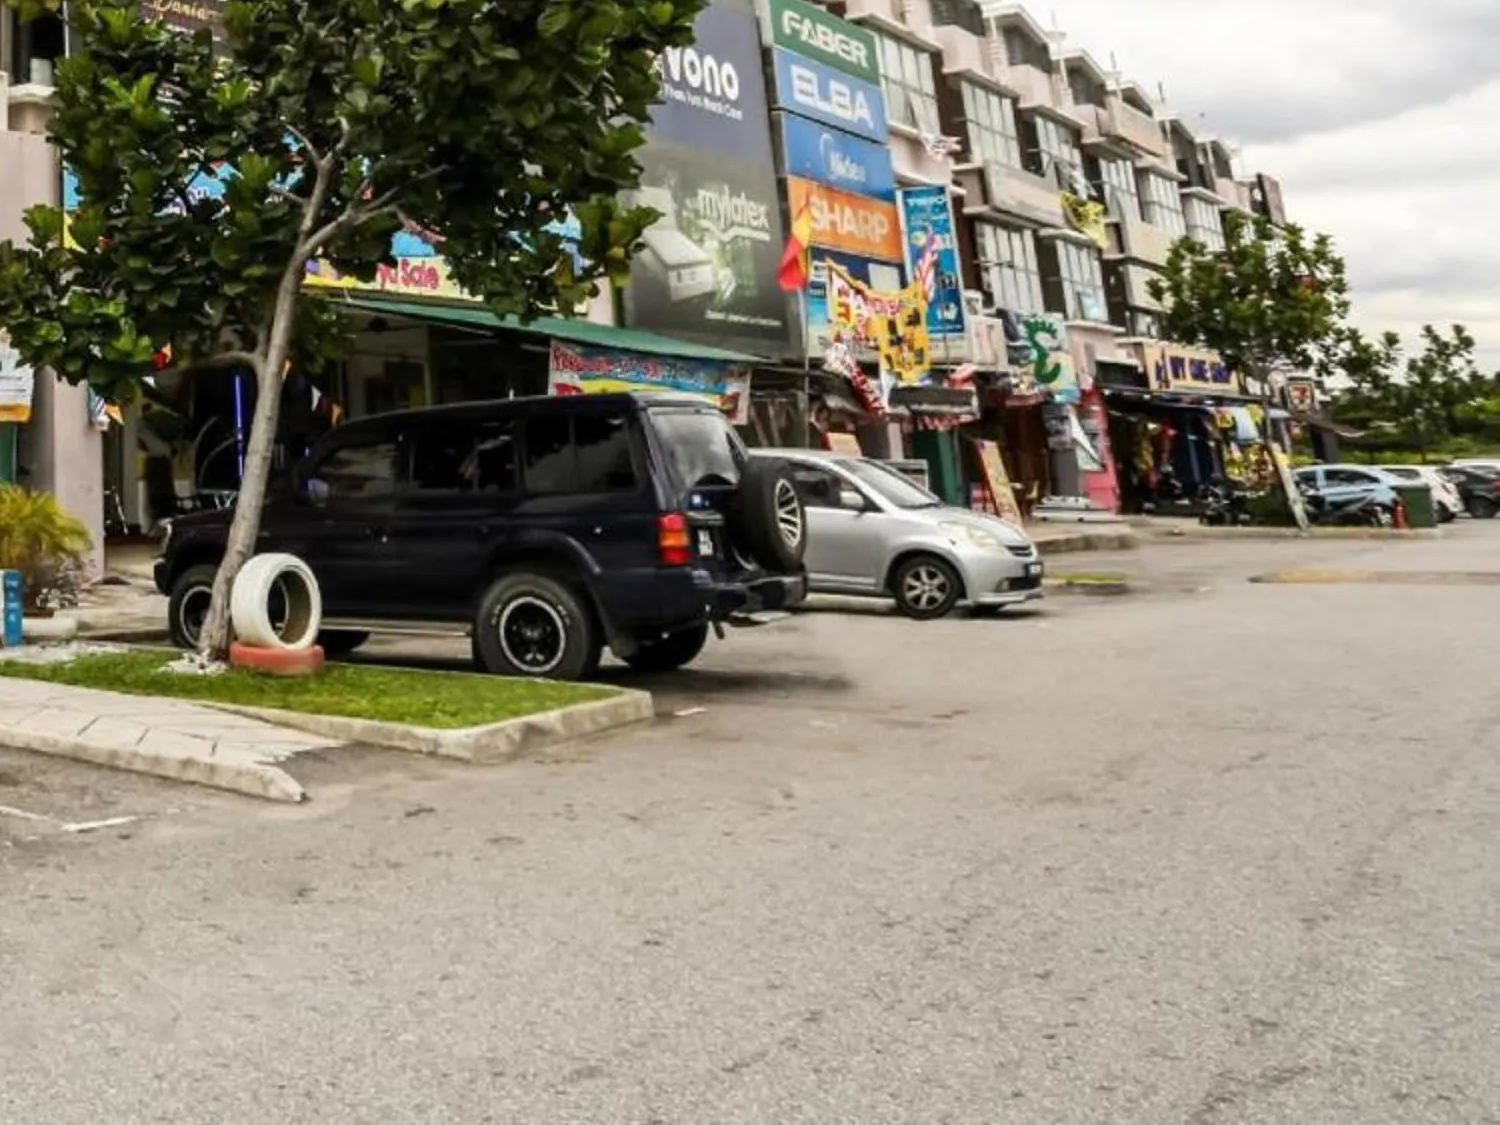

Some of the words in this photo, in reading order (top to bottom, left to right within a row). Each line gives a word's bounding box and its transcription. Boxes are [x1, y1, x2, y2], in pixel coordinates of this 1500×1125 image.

[780, 8, 871, 69] FABER
[664, 45, 740, 102] vono
[789, 62, 874, 129] ELBA
[697, 183, 770, 230] mylatex
[808, 194, 889, 243] SHARP
